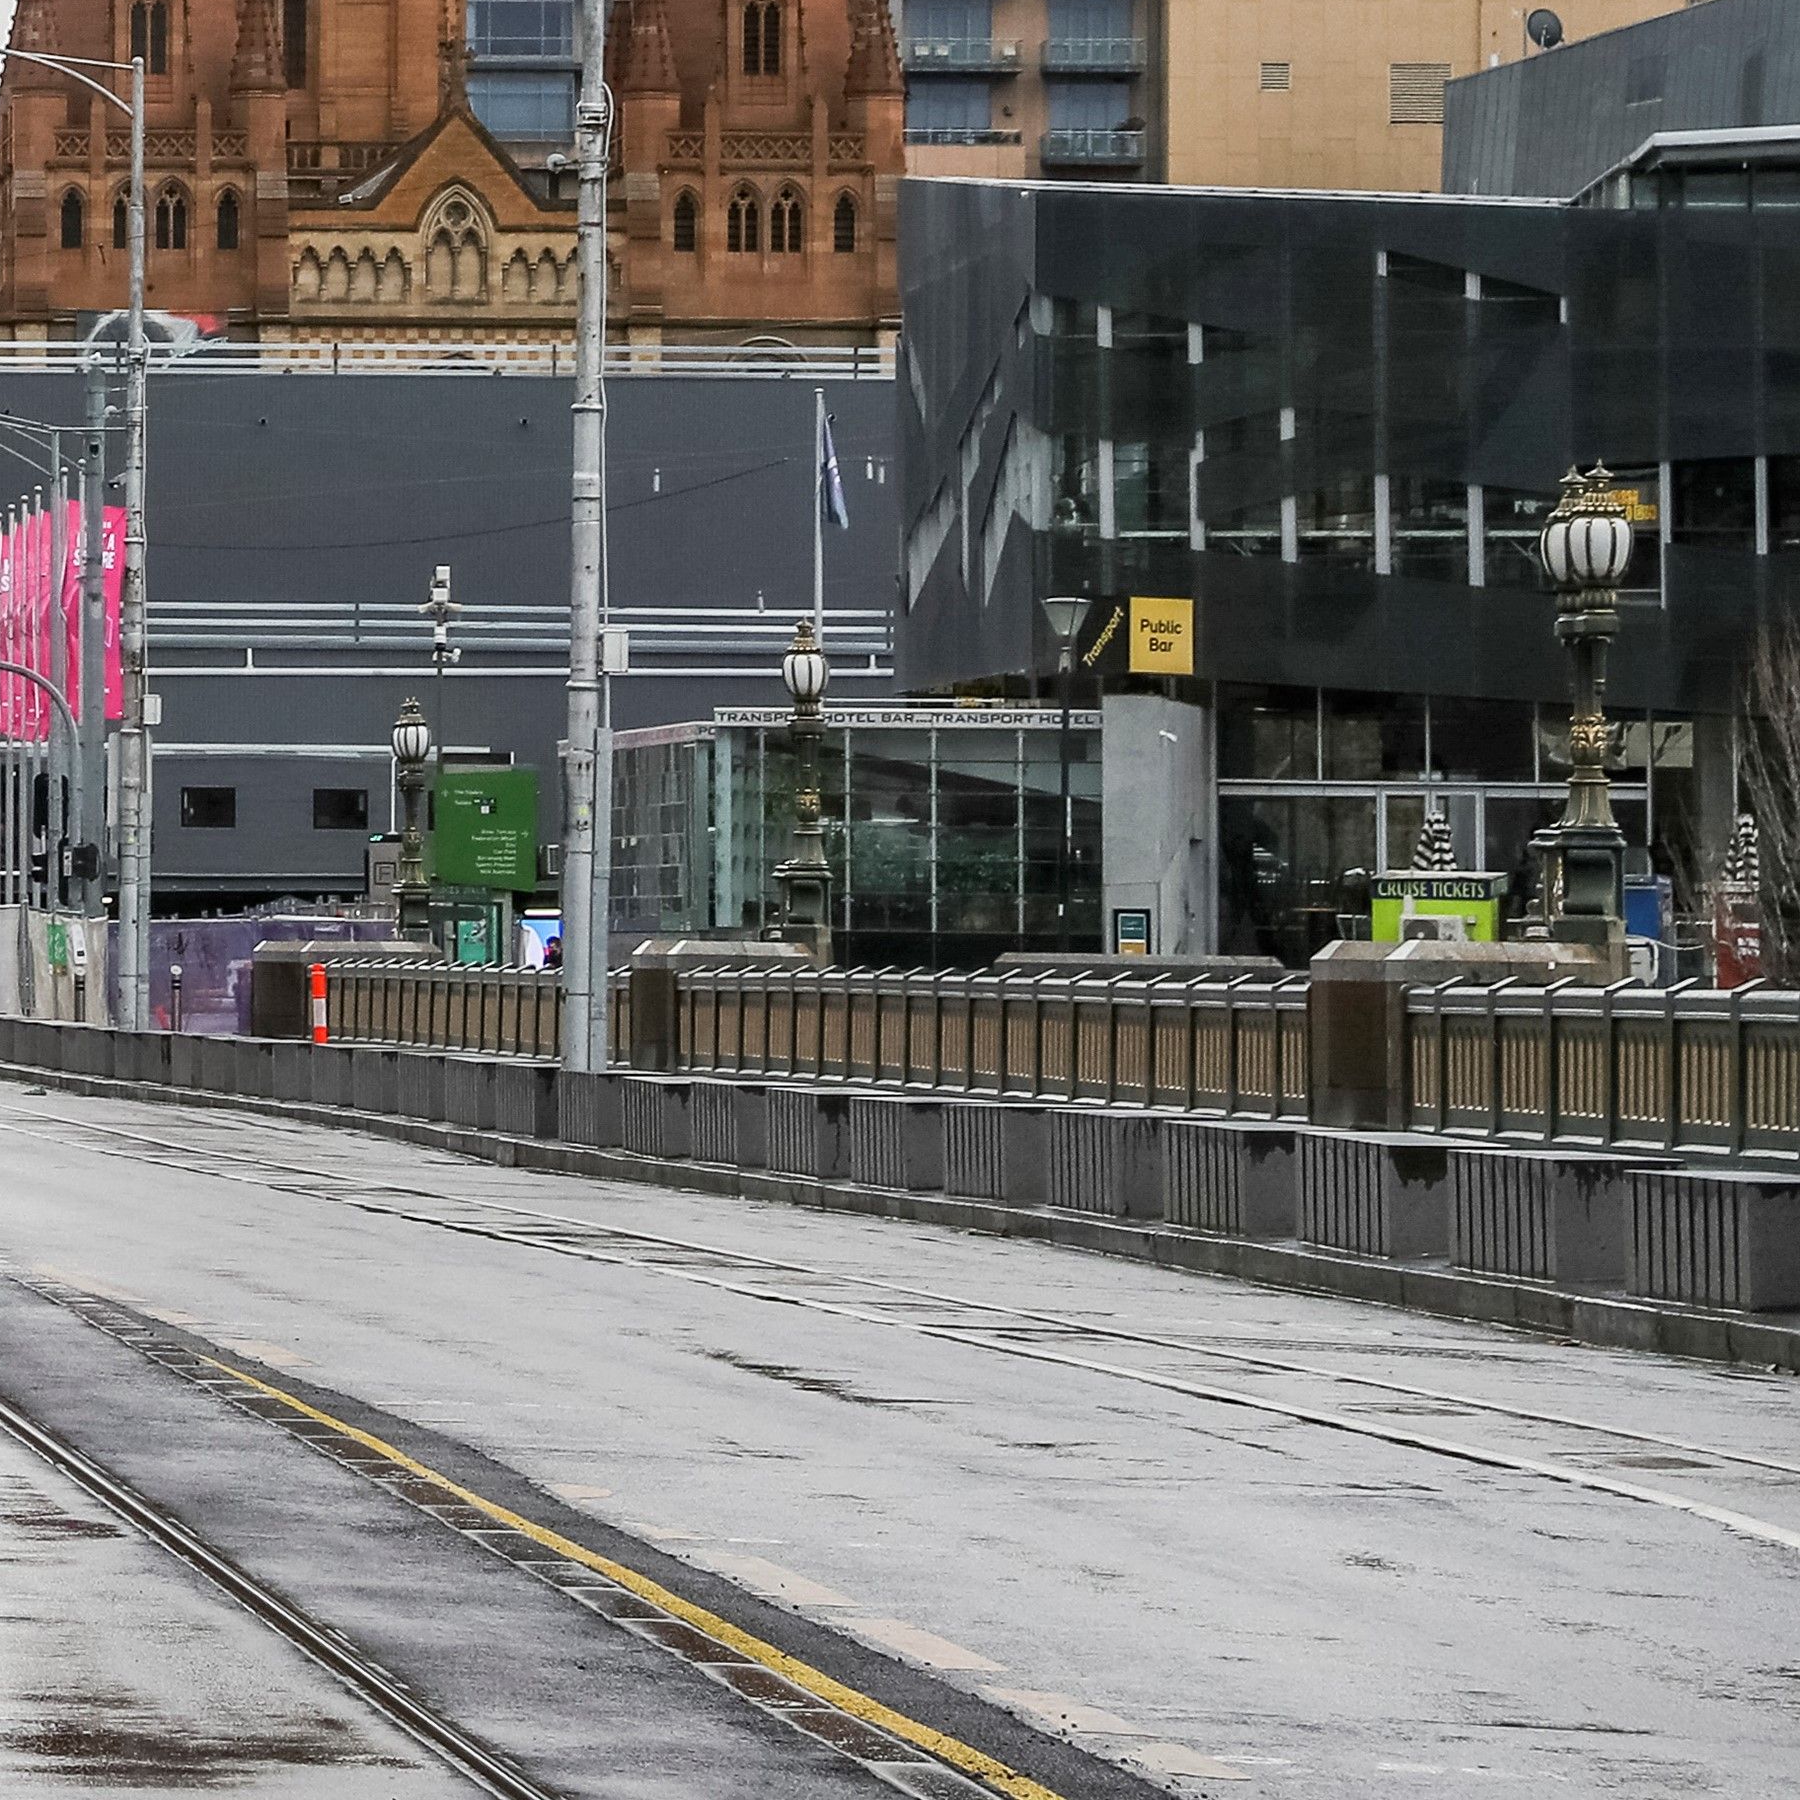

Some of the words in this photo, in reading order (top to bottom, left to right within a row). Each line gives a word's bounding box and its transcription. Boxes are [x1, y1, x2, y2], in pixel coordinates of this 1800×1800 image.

[1140, 618, 1183, 635] Public
[1082, 605, 1124, 667] Transport
[1149, 637, 1173, 652] Bar
[933, 713, 1032, 723] TRANSPORT
[1377, 880, 1428, 897] CRUISE
[1431, 881, 1485, 898] TICKETS
